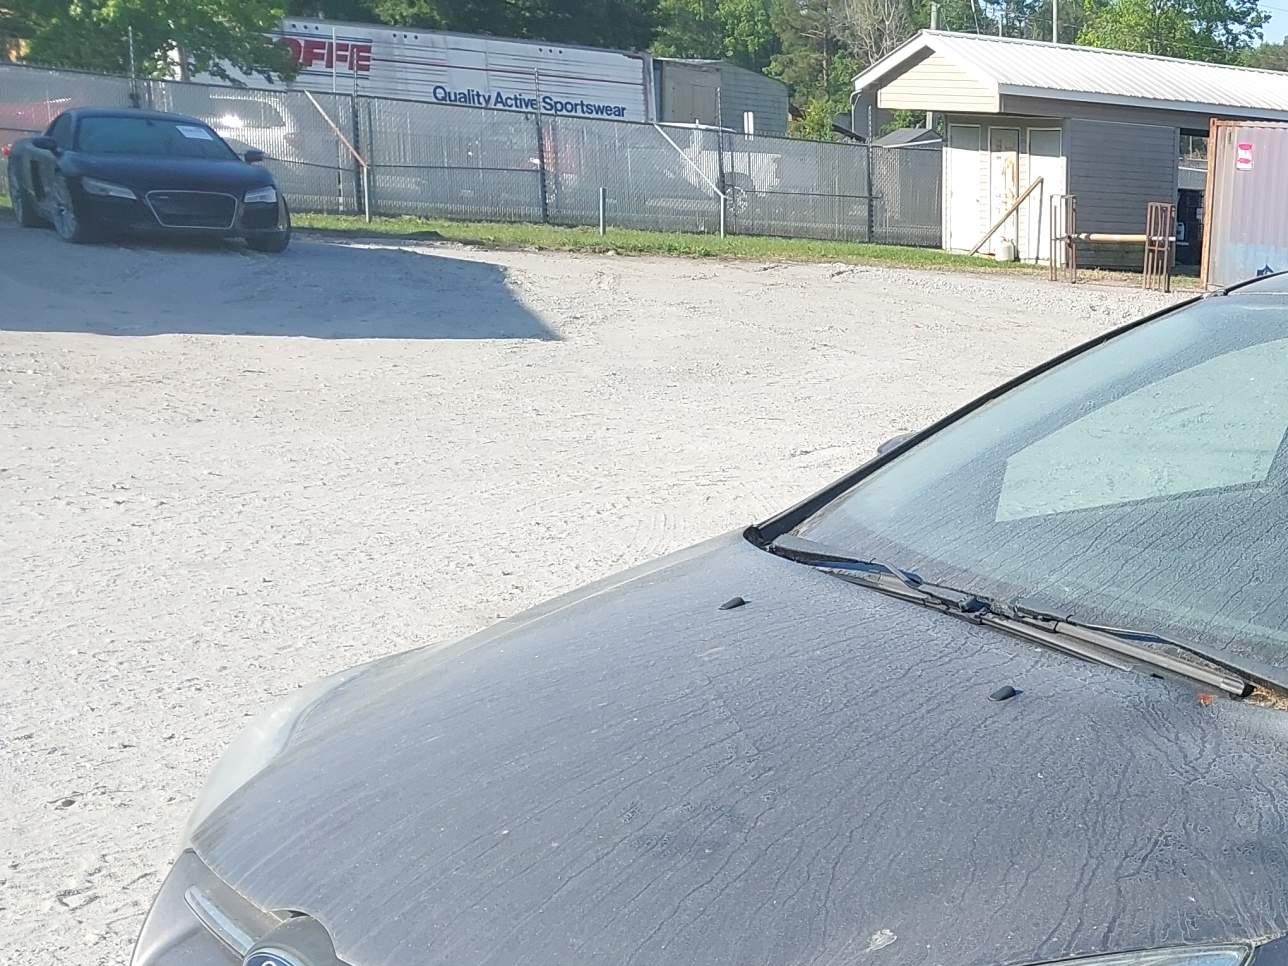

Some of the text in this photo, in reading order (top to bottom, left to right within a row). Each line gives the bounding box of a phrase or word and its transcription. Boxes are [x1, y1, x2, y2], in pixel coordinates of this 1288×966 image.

[432, 85, 627, 118] Quality Active Sportswear
